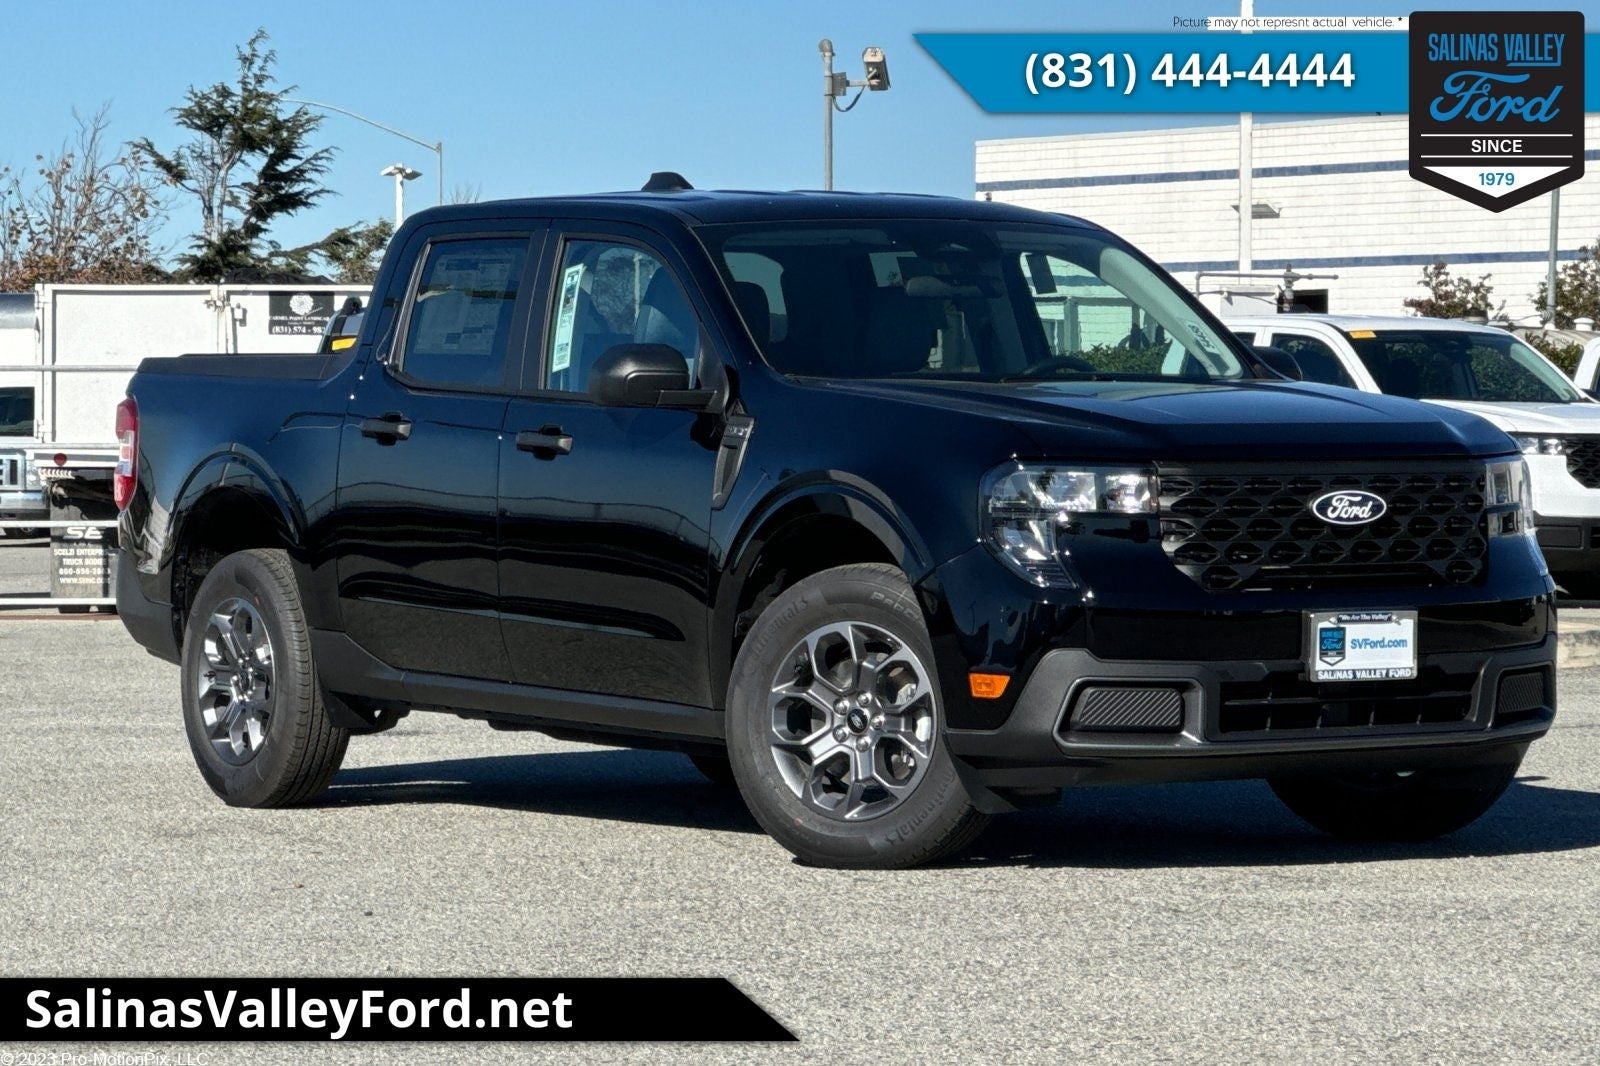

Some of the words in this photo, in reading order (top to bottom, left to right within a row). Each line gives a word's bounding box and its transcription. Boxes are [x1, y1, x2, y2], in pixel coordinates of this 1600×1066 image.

[1327, 495, 1373, 519] Ford
[63, 558, 83, 566] TRUCK
[1350, 637, 1408, 650] SVFord.com
[1318, 669, 1354, 680] SALINAS
[1355, 669, 1387, 679] VALLEY
[1389, 668, 1412, 678] FORD
